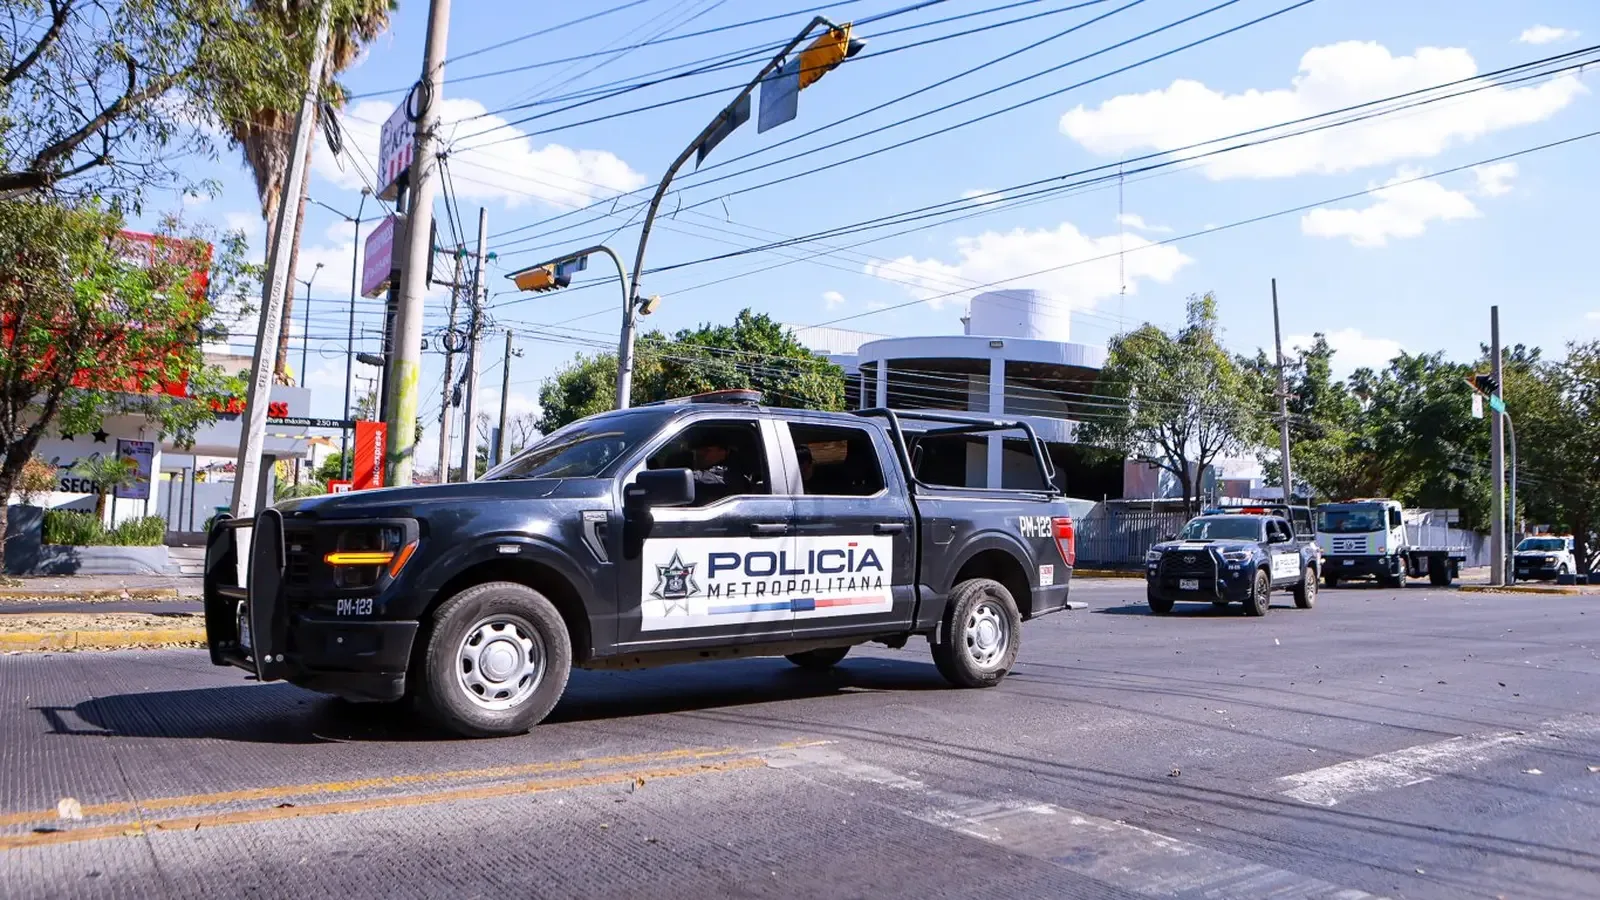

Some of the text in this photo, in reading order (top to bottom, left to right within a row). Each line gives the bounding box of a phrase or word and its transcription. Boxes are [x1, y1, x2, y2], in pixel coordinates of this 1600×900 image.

[1019, 516, 1052, 537] PM-123
[708, 542, 884, 579] POLICÍA
[707, 575, 883, 599] METROPOLITANA
[336, 598, 374, 616] PM-123
